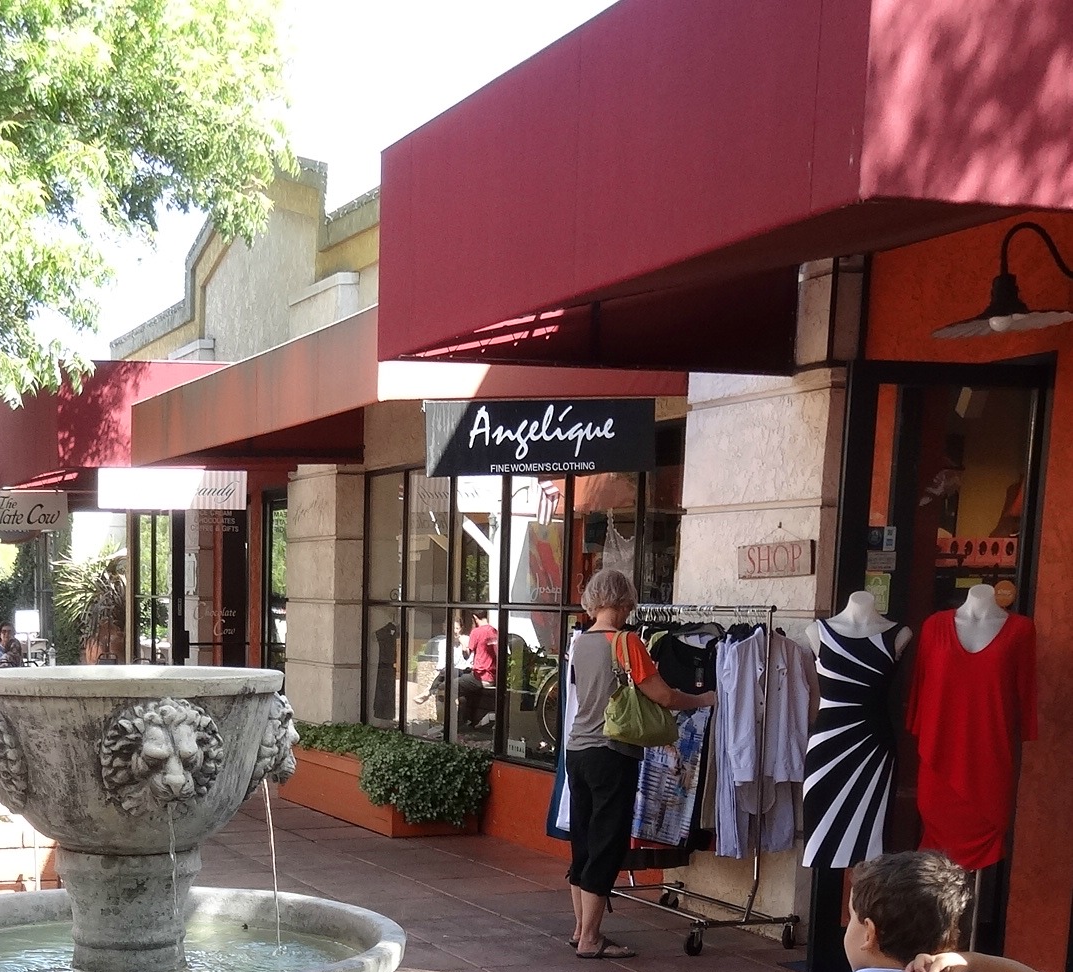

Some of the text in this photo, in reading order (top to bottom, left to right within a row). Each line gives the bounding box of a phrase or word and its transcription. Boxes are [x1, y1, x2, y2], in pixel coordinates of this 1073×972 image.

[490, 461, 596, 473] FINE WOMEN'S CLOTHING
[195, 480, 240, 504] andy
[26, 503, 61, 525] Cow
[746, 543, 803, 575] SHOP
[213, 619, 236, 637] Cow
